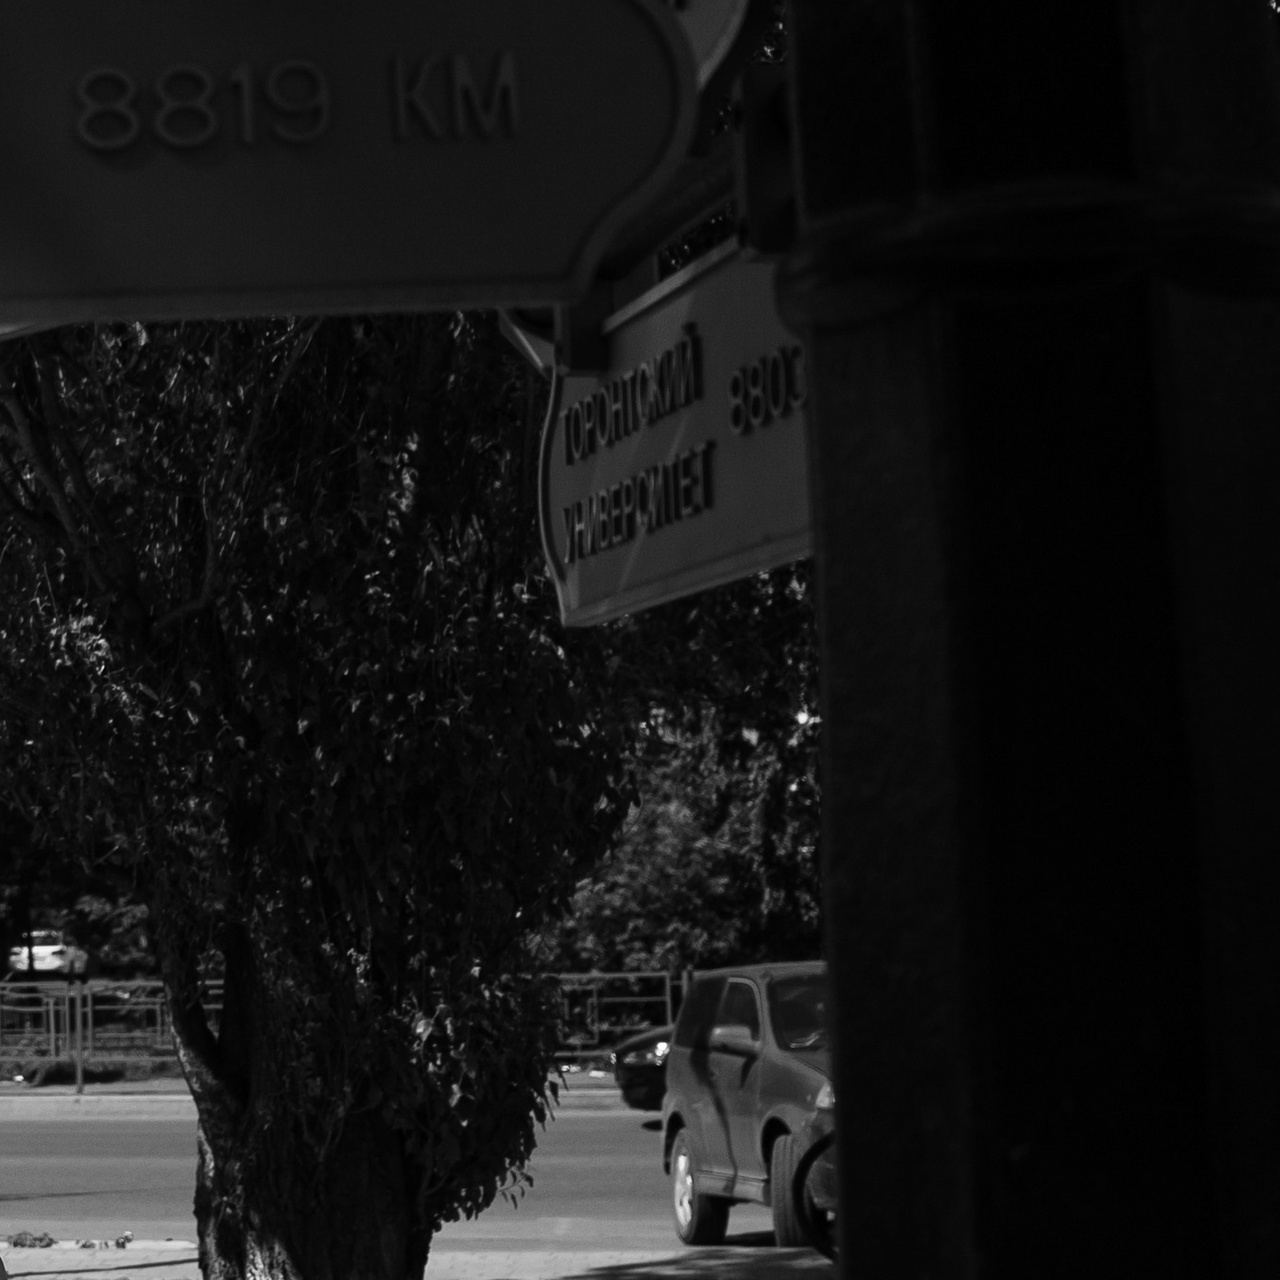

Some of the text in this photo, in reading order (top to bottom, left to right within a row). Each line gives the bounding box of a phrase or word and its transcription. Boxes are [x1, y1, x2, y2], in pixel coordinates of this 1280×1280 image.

[75, 50, 519, 150] 8819 КМ
[562, 439, 715, 564] УНИВЕРСИТЕТ
